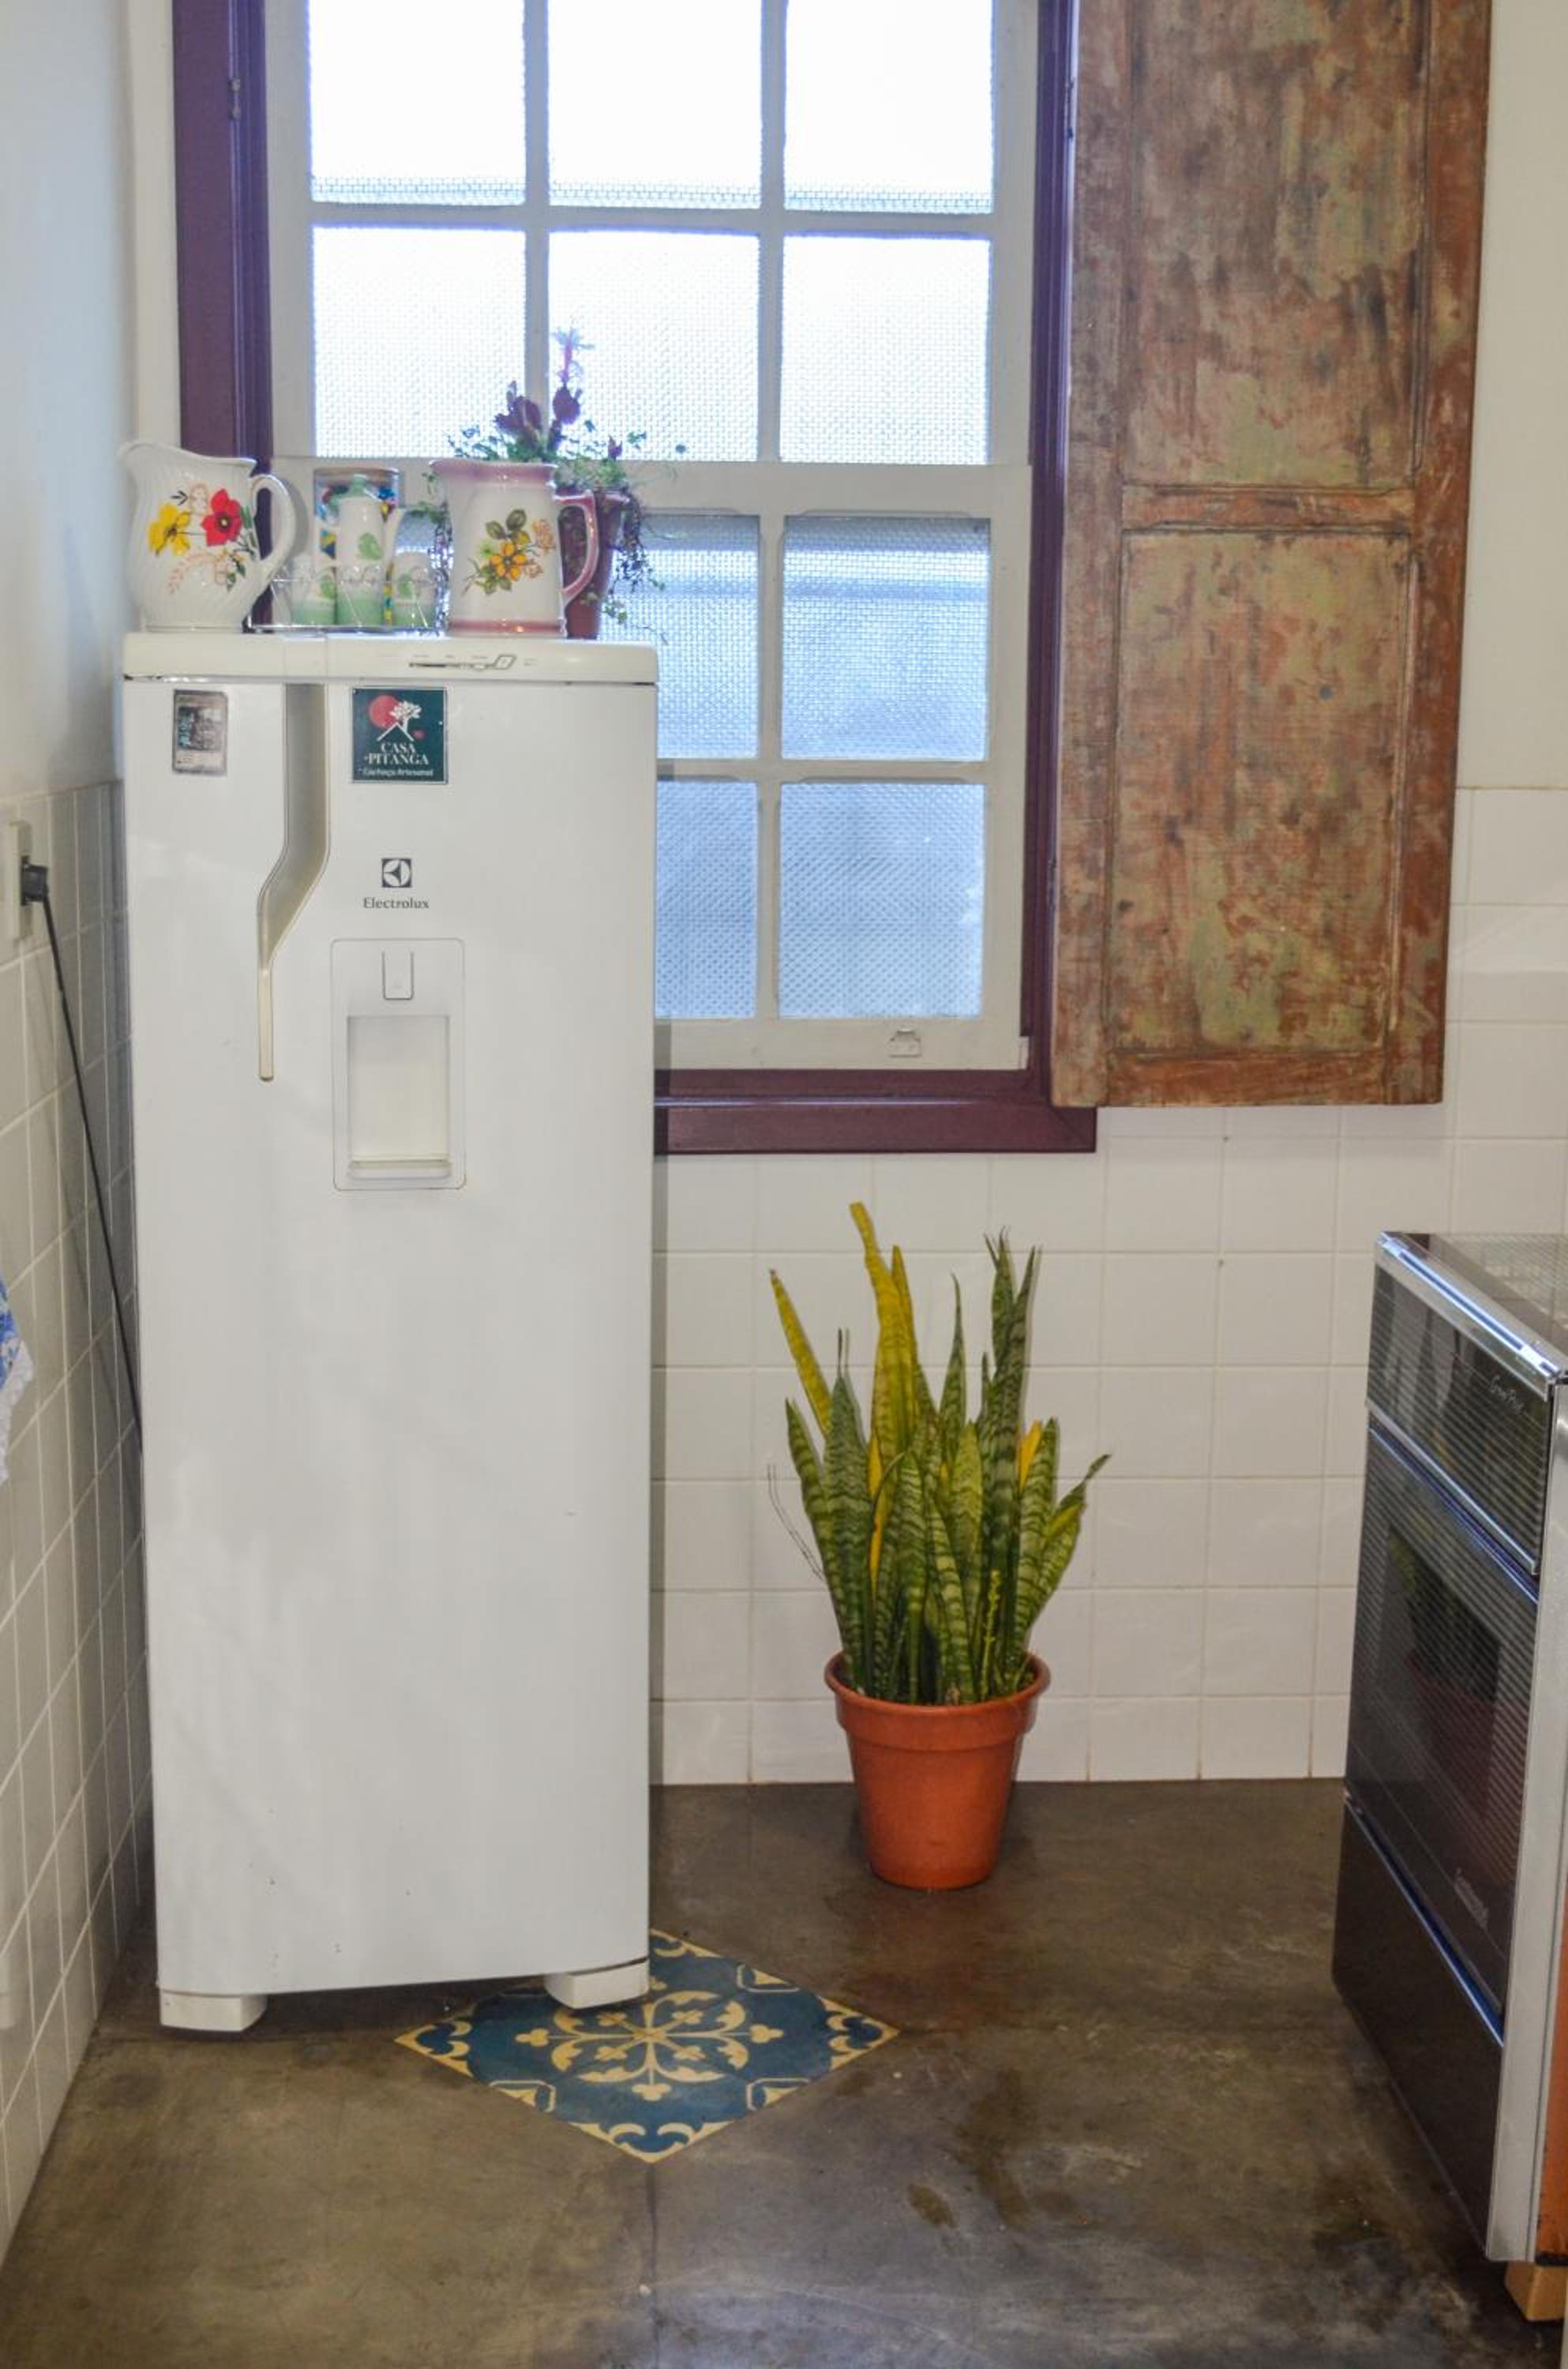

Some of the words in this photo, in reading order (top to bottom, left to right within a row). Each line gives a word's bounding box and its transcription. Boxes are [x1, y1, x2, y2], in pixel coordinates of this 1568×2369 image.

[381, 742, 416, 753] CASA
[369, 753, 430, 765] PITANGA
[363, 897, 430, 909] Electrolux
